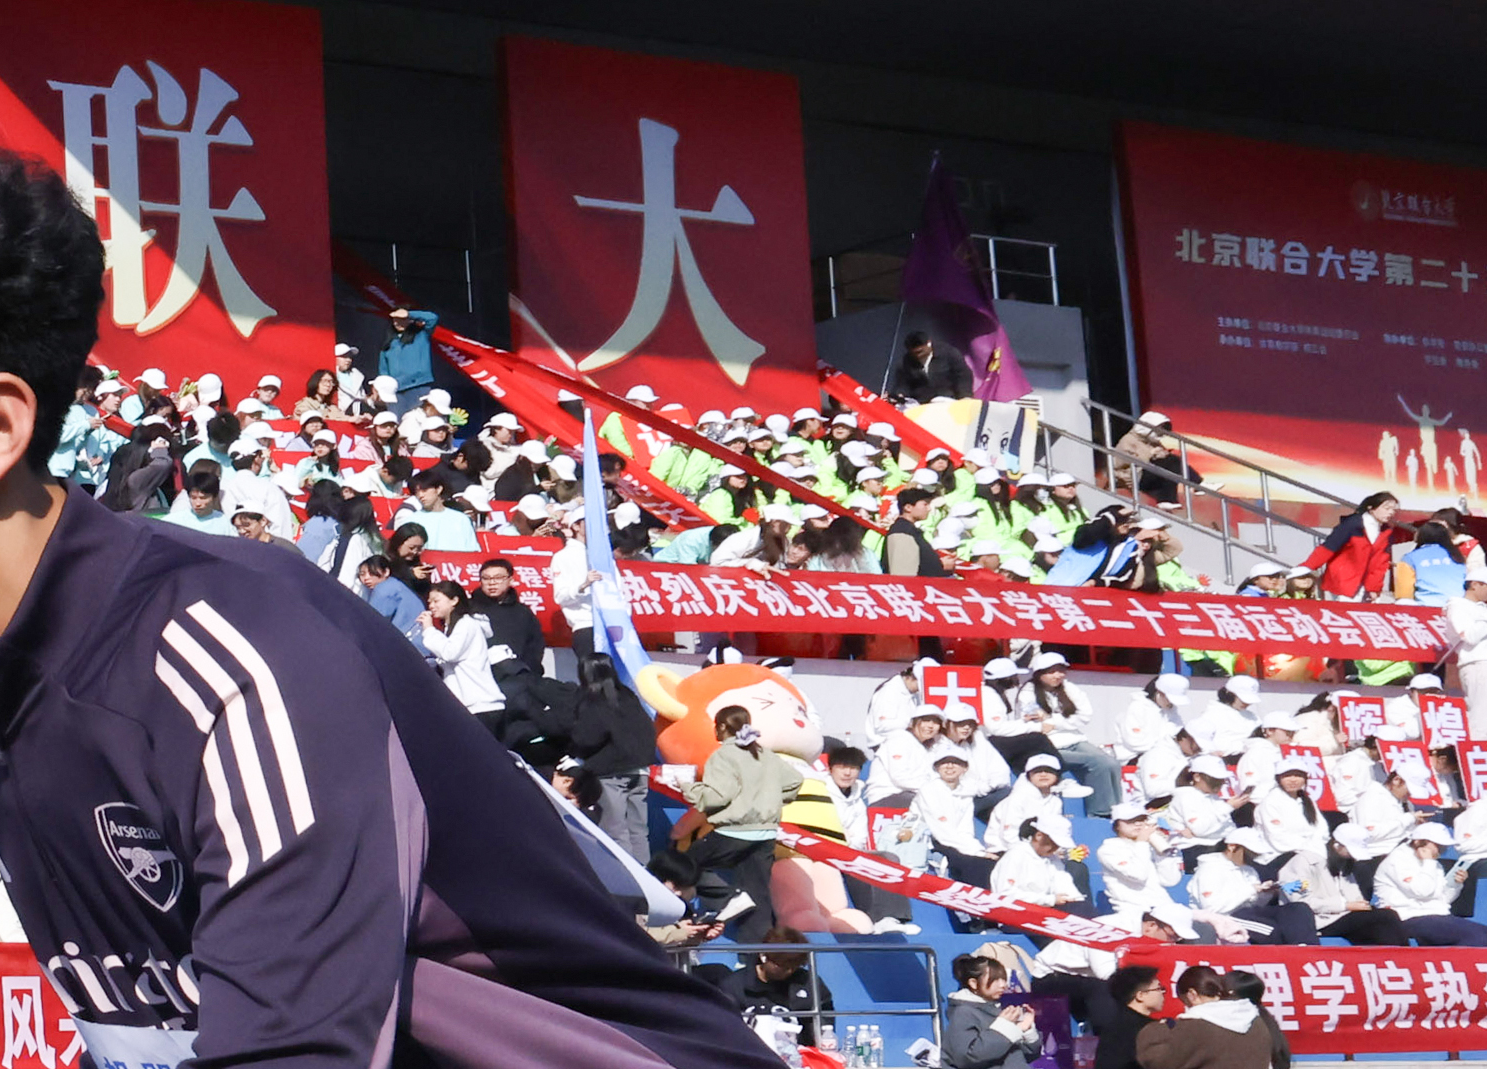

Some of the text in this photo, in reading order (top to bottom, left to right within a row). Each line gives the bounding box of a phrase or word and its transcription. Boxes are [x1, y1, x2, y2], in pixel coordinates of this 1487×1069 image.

[47, 59, 278, 338] 联
[574, 117, 766, 386] 大
[1174, 228, 1479, 293] 北京联合大学第二十
[1424, 701, 1465, 747] 煌
[1171, 960, 1487, 1032] 理学院热
